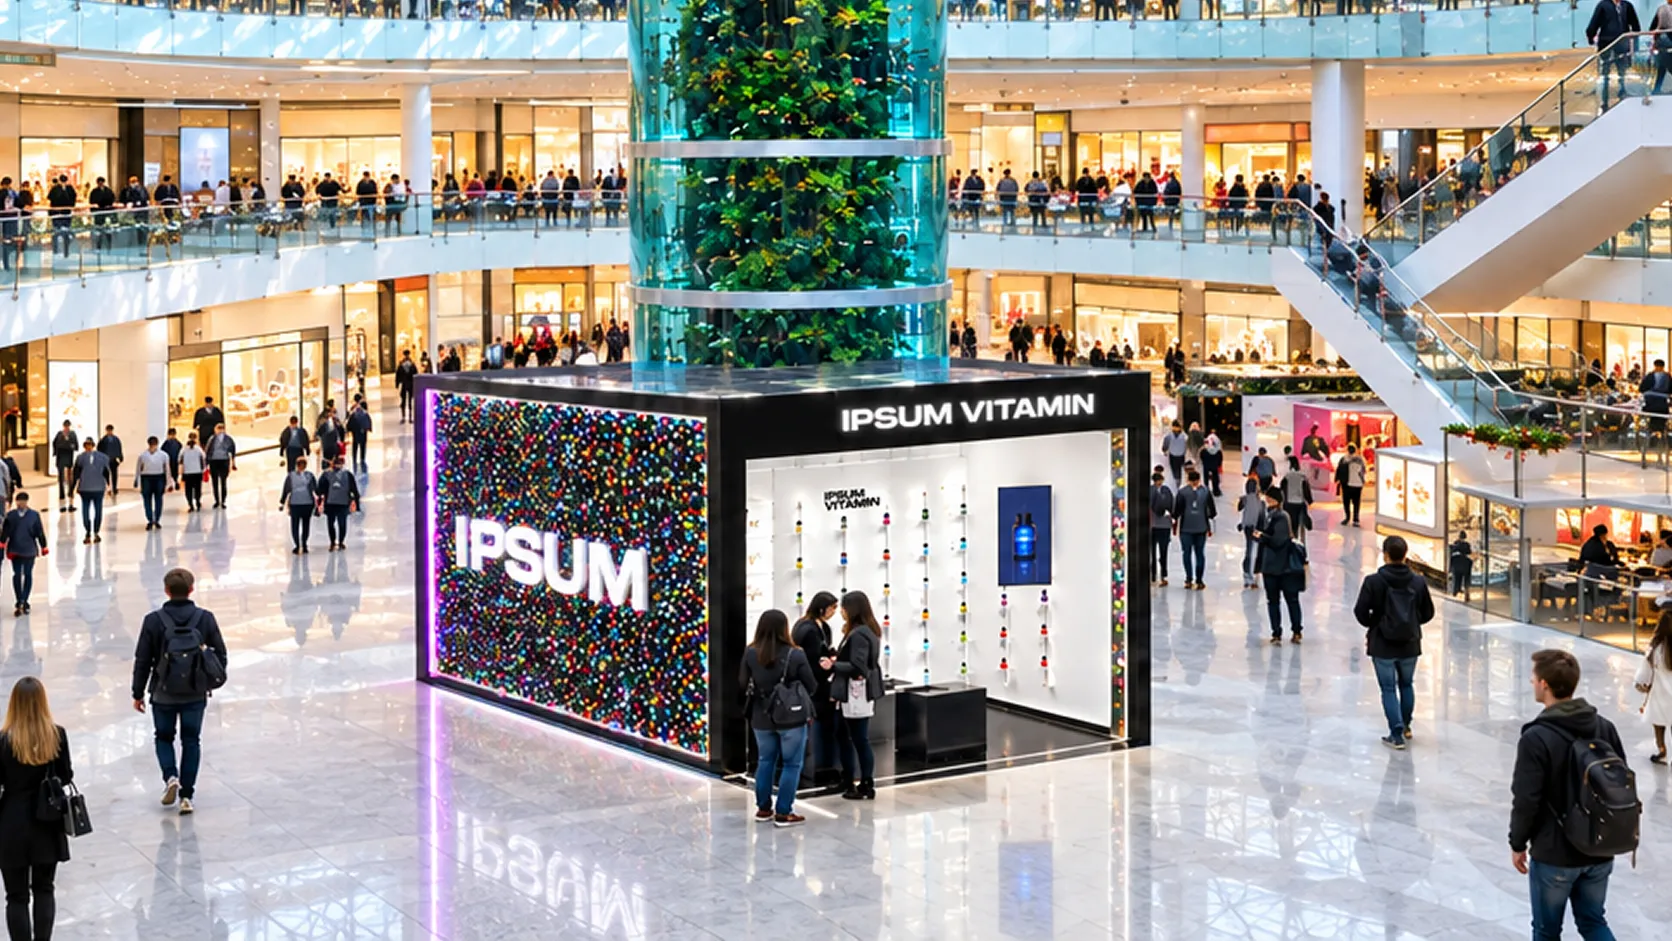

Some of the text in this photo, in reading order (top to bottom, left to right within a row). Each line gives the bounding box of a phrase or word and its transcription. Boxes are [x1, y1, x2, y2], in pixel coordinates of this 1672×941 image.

[841, 393, 1095, 432] IPSUM VITAMIN
[825, 497, 880, 510] VITAMIN
[455, 515, 649, 611] IPSUM
